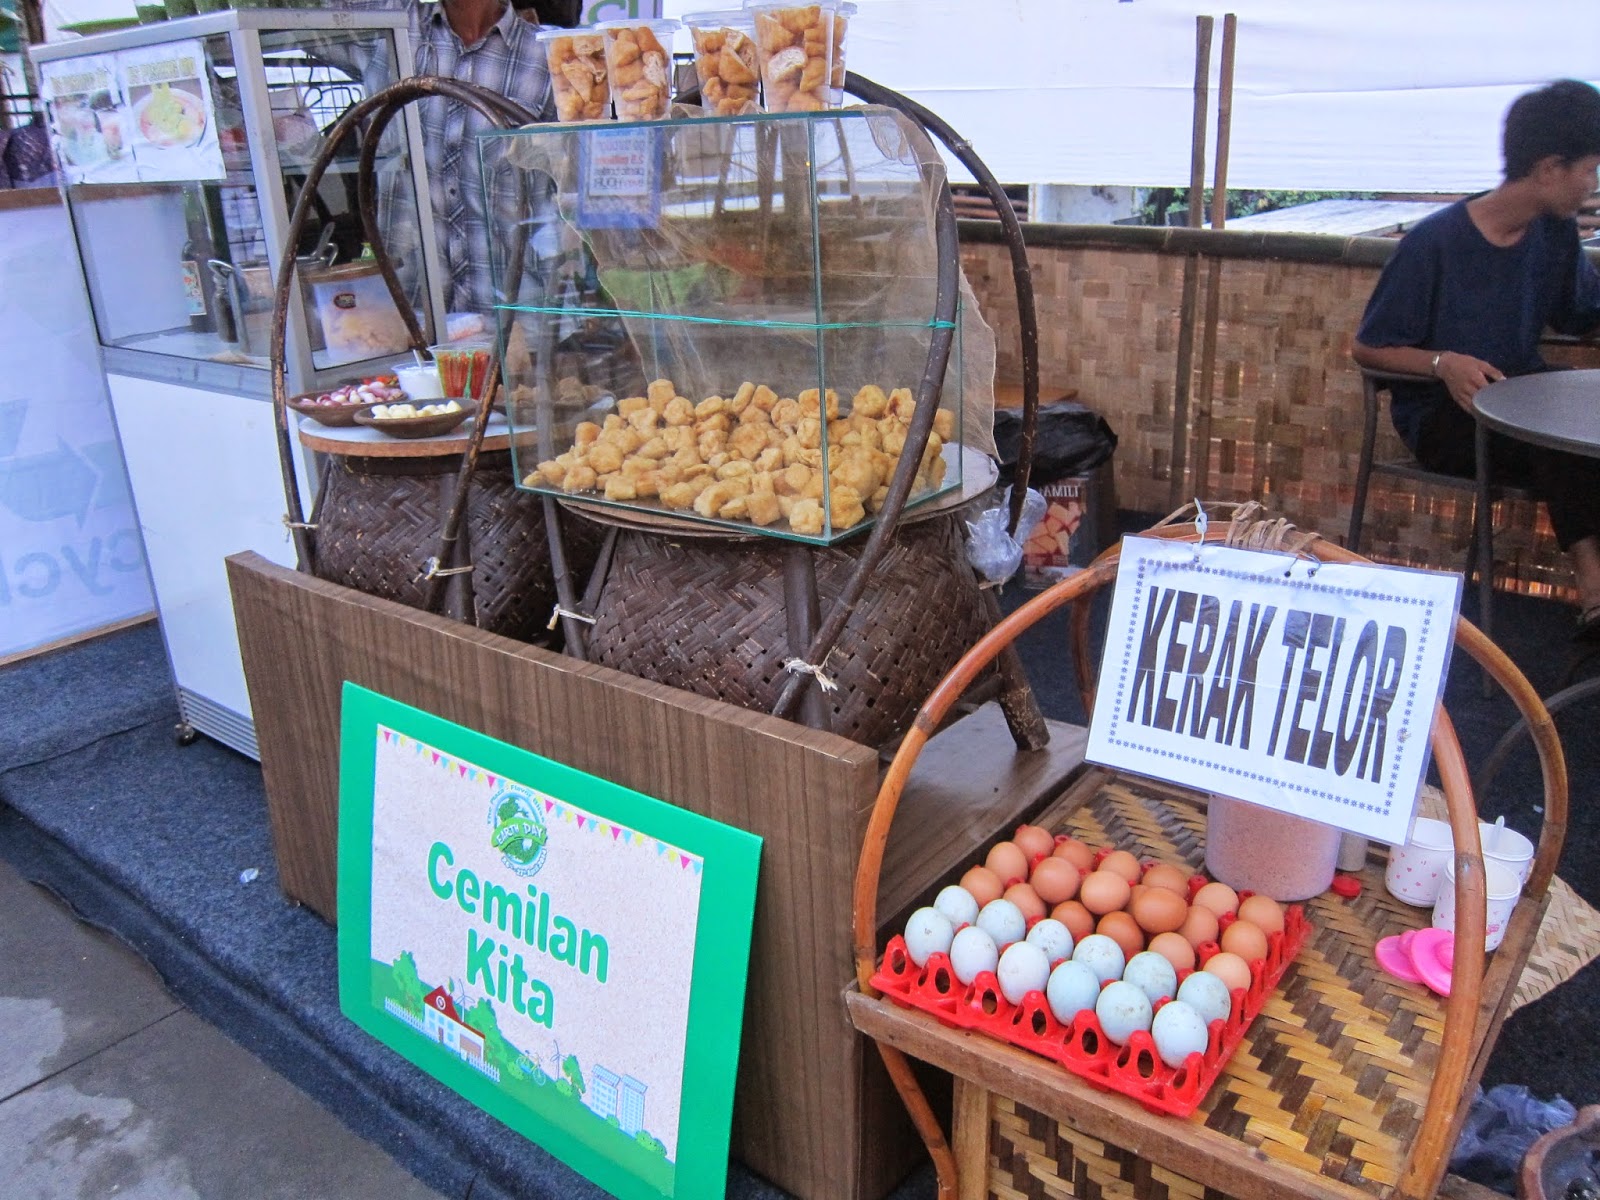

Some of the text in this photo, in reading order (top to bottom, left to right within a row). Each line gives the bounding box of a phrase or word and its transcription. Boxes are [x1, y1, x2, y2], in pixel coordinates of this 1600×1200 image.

[1126, 586, 1407, 784] KERAK TELOR
[496, 822, 543, 845] EARTH DAY
[427, 841, 609, 984] Cemilan
[466, 928, 554, 1029] Kita
